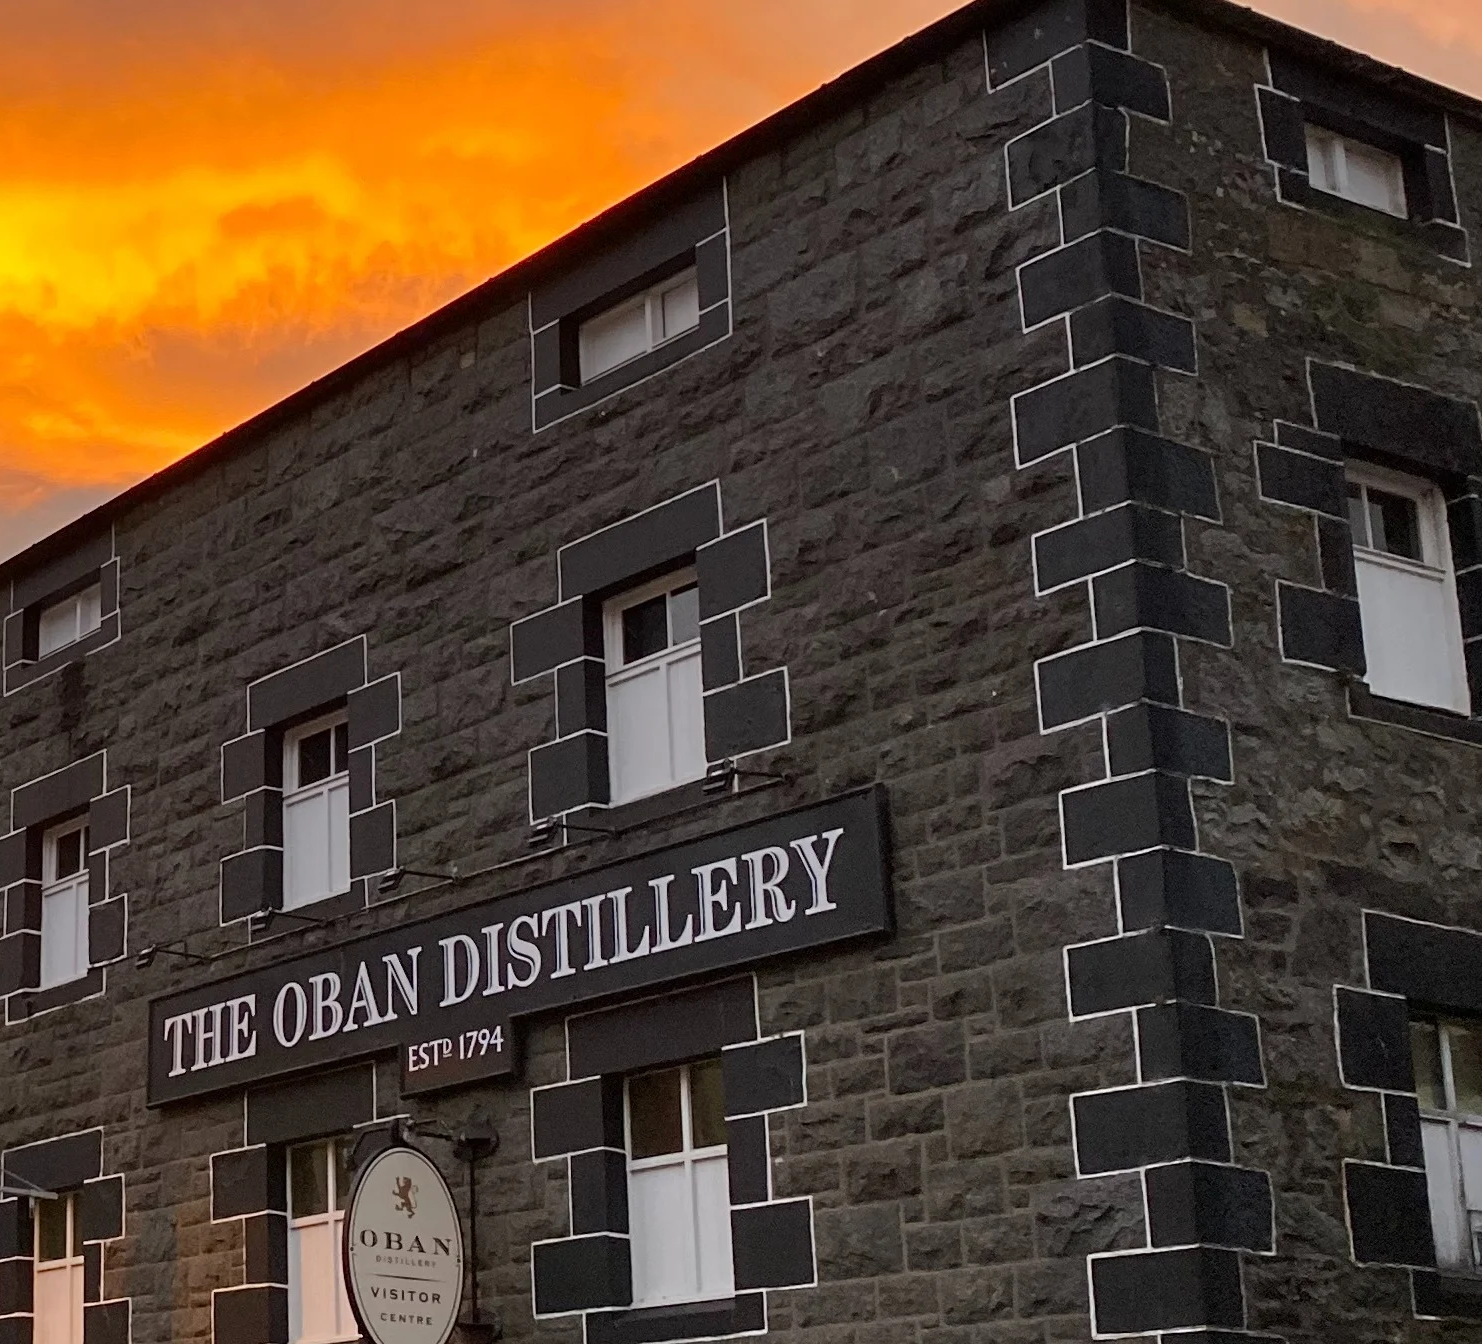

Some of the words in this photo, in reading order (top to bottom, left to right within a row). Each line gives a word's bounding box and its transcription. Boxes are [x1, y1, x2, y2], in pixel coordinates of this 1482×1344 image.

[163, 994, 257, 1078] THE
[272, 946, 423, 1048] OBAN
[438, 827, 845, 1008] DISTILLERY
[458, 1025, 505, 1060] 1794
[359, 1229, 452, 1256] OBAN
[375, 1256, 437, 1268] DISTILLERY
[370, 1286, 441, 1304] VISITOR
[379, 1312, 433, 1326] CENTRE
